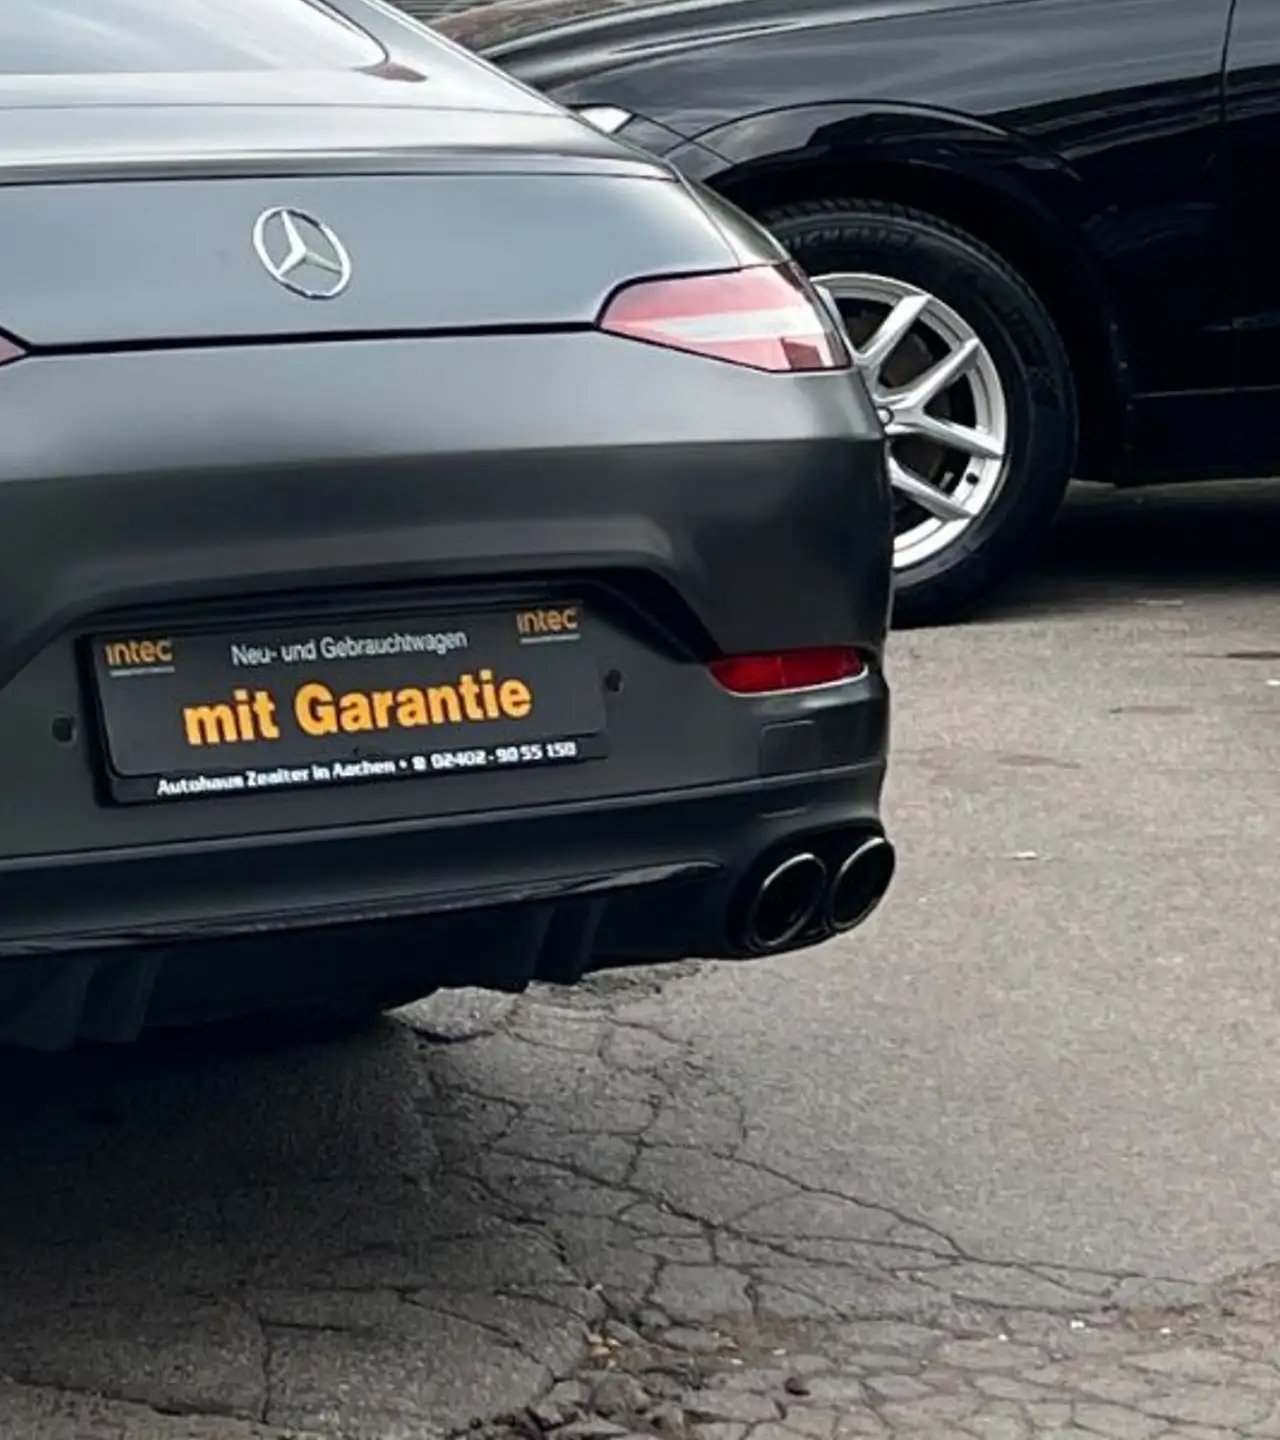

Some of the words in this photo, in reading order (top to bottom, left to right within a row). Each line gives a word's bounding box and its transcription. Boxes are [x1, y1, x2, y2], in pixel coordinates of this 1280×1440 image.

[516, 607, 578, 634] intec
[105, 639, 173, 666] intec
[230, 643, 277, 666] Neu-
[282, 639, 317, 662] und
[320, 630, 468, 660] Gebrauchtwagen
[182, 687, 280, 746] mit
[294, 669, 533, 737] Garantie
[157, 774, 245, 796] Autohaus
[312, 763, 331, 781] in
[333, 759, 396, 778] Aachen
